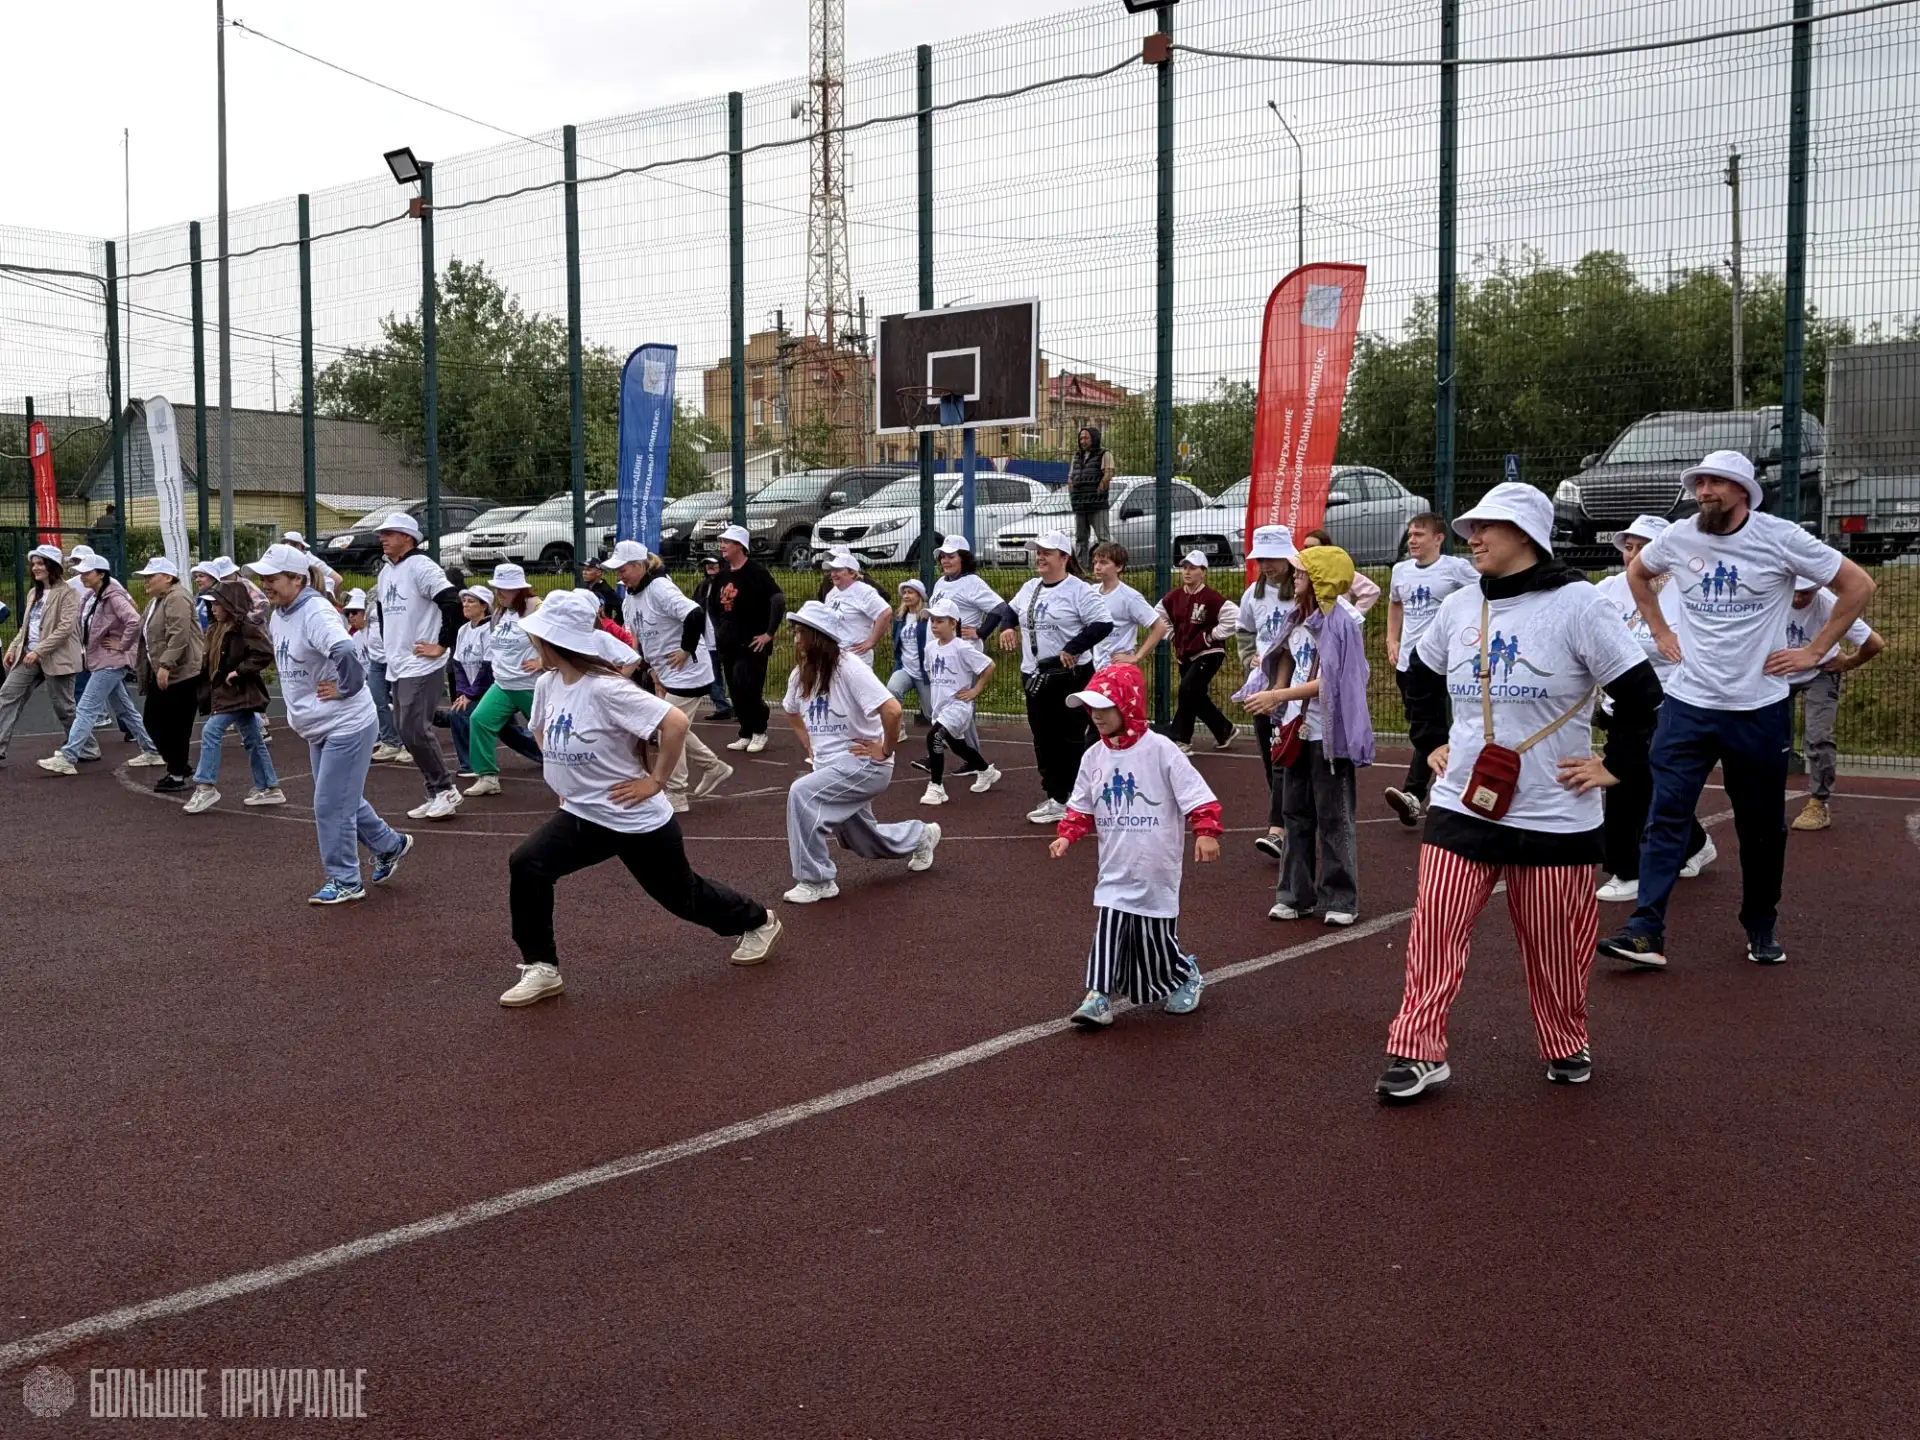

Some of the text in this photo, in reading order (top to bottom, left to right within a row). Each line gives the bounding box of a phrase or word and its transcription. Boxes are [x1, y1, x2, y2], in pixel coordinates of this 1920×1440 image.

[1269, 407, 1294, 525] ПАЛЬНОЕ УЧРЕЖДЕНИЕ
[1716, 602, 1765, 612] СПОРТА
[1489, 685, 1548, 699] СПОРТА
[819, 723, 848, 732] СПОРТА
[558, 751, 598, 761] СПОРТА
[1117, 816, 1159, 827] СПОРТА
